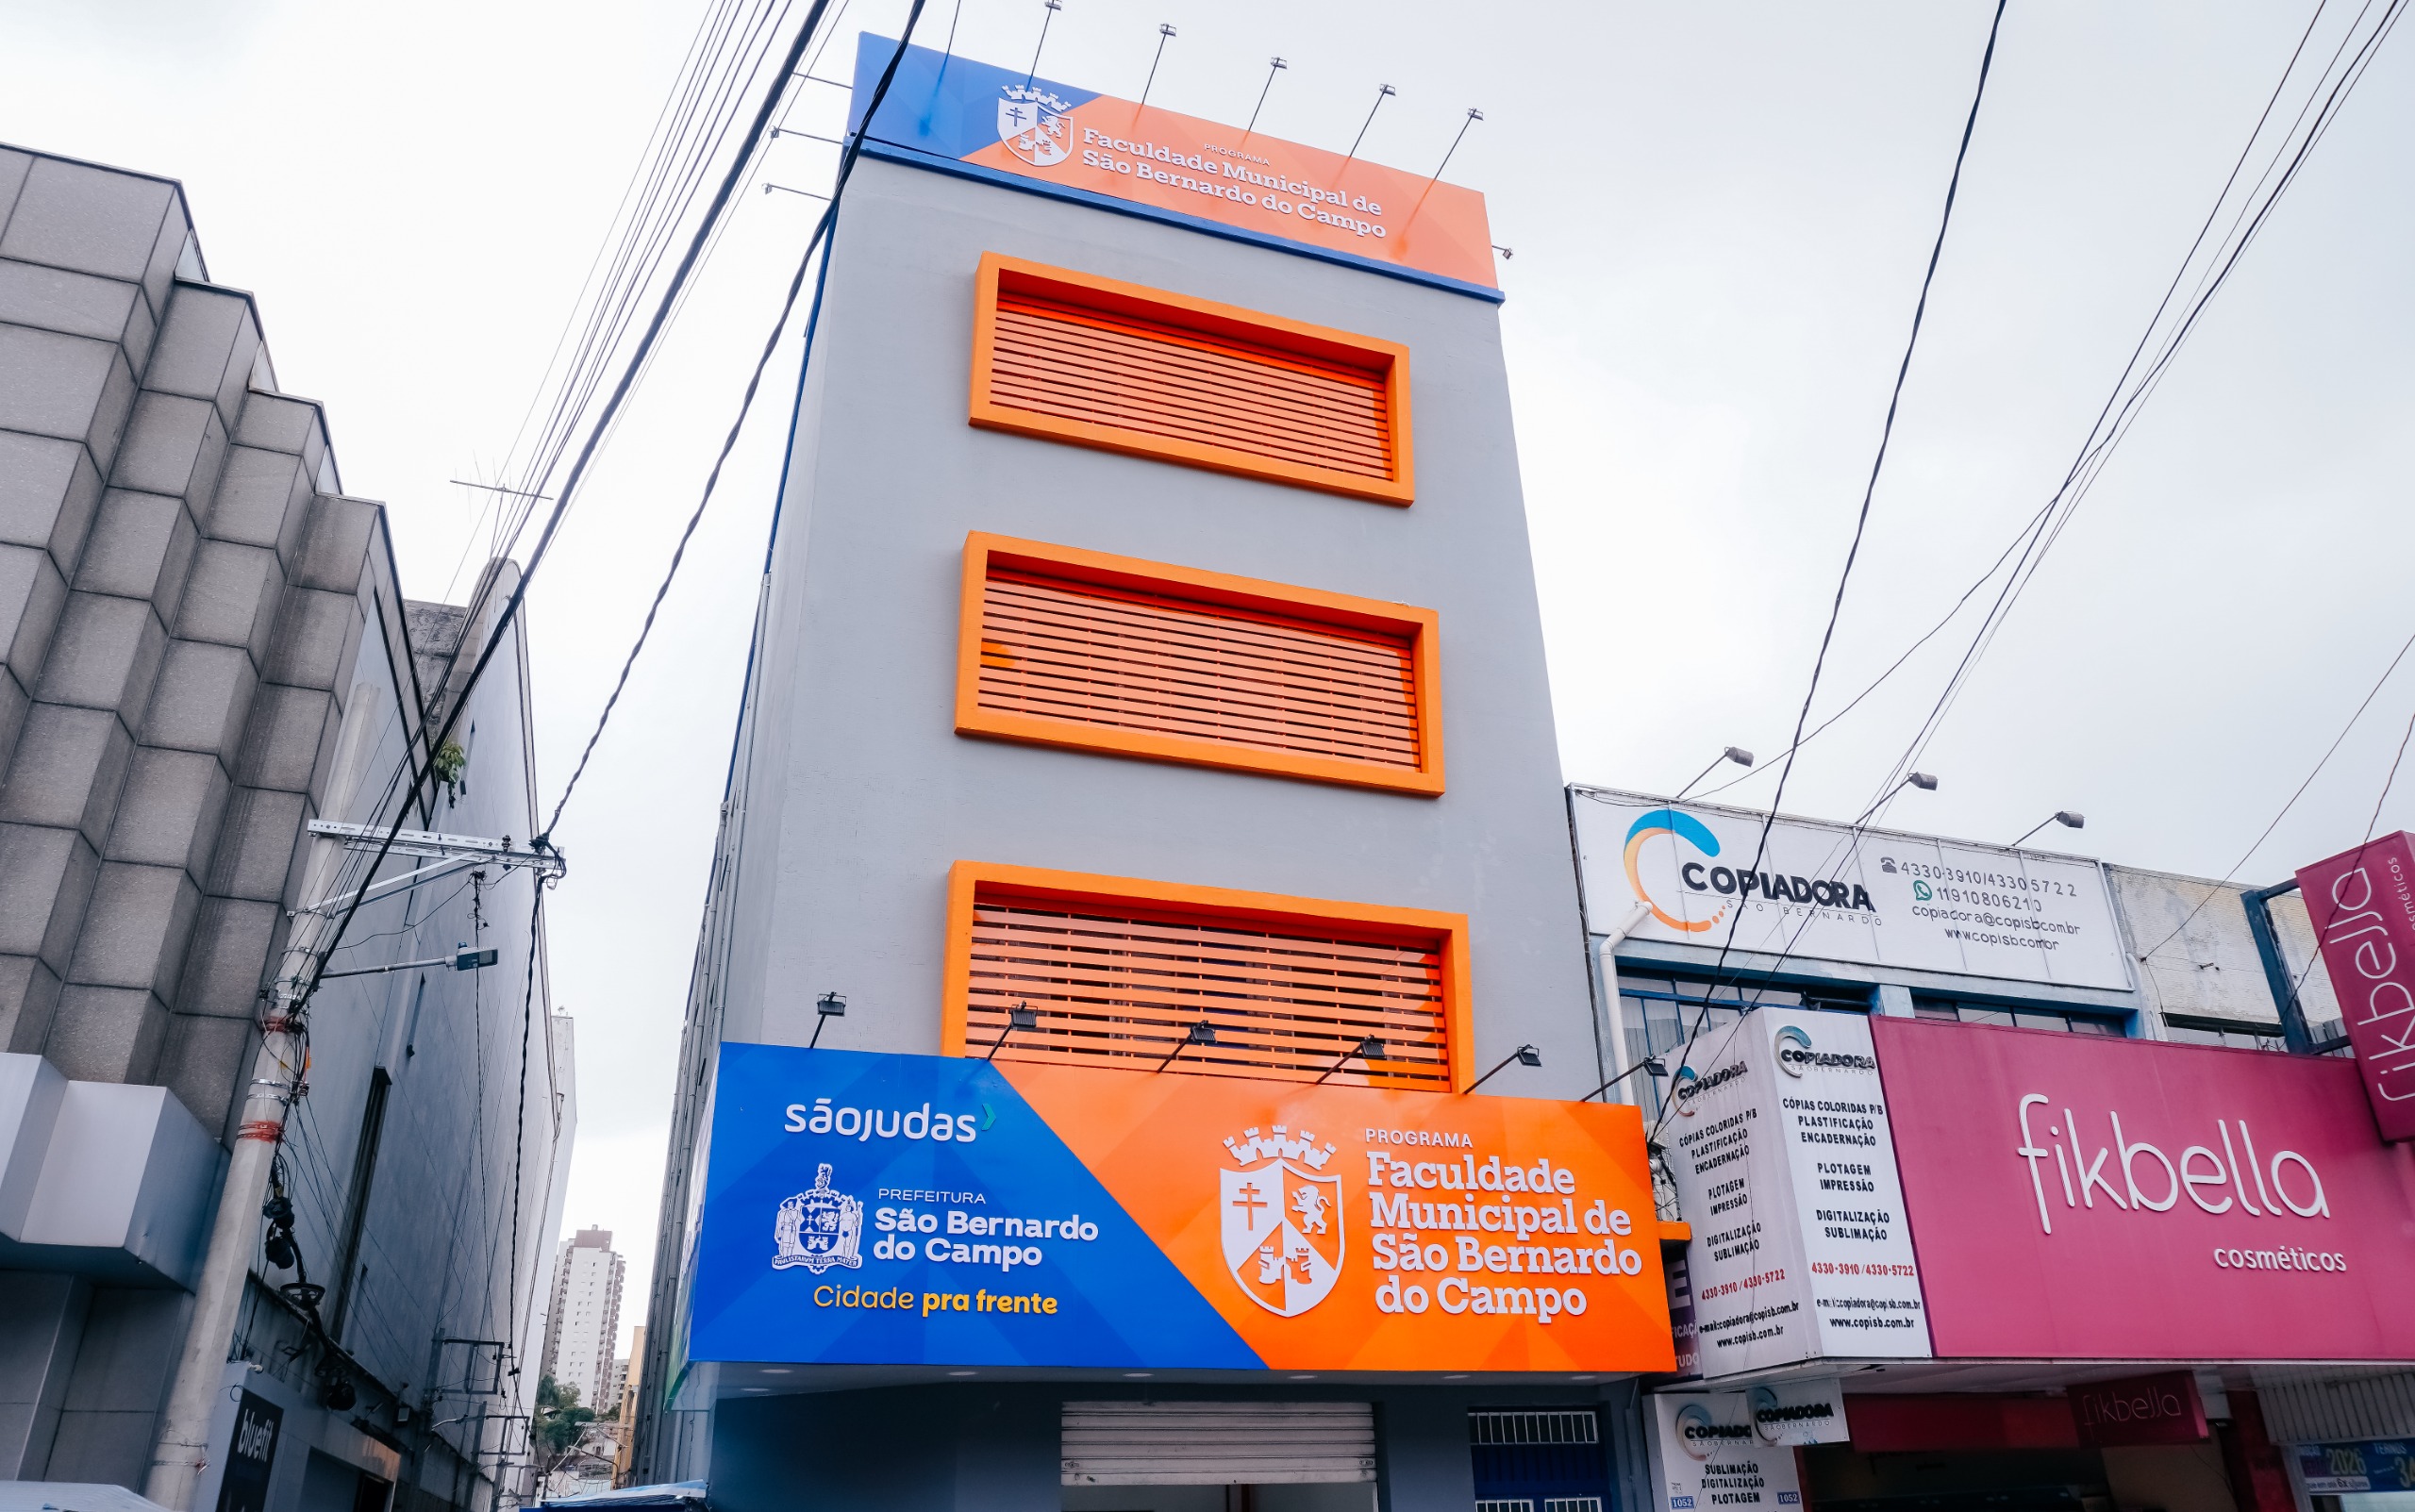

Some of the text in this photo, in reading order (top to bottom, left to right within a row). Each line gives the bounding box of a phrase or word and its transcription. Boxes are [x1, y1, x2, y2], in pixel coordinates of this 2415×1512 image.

[1204, 143, 1271, 166] PROGRAMA
[1083, 127, 1382, 216] Faculdade Municipal de
[1082, 149, 1387, 238] São Bernardo do Campo
[1681, 861, 1877, 913] COPIADORA
[1780, 1048, 1876, 1069] COPIADORA
[1678, 1060, 1749, 1101] COPIADORA
[1782, 1096, 1884, 1115] CÓPIAS COLORIDAS P/B
[784, 1098, 976, 1143] sãojudas
[1679, 1108, 1757, 1148] CÓPIAS COLORIDAS P/B
[1797, 1116, 1874, 1132] PLASTIFICAÇÃO
[1365, 1128, 1474, 1149] PROGRAMA
[1690, 1127, 1748, 1159] PLASTIFICAÇÃO
[1801, 1132, 1876, 1148] ENCADERNAÇÃO
[1694, 1143, 1750, 1174] ENCADERNAÇÃO
[1817, 1162, 1872, 1175] PLOTAGEM
[2017, 1093, 2331, 1235] fikbella
[1366, 1151, 1576, 1195] Faculdade
[1820, 1178, 1874, 1192] IMPRESSÃO
[878, 1188, 987, 1205] PREFEITURA
[1707, 1177, 1745, 1200] PLOTAGEM
[1709, 1192, 1748, 1216] IMPRESSÃO
[874, 1207, 1099, 1241] São Bernardo
[1369, 1192, 1632, 1241] Municipal de
[1816, 1208, 1890, 1226] DIGITALIZAÇÃO
[1707, 1220, 1761, 1247] DIGITALIZAÇÃO
[1824, 1226, 1888, 1242] SUBLIMAÇÃO
[873, 1234, 1042, 1272] do Campo
[1372, 1233, 1643, 1276] São Bernardo
[1713, 1238, 1760, 1262] SUBLIMAÇÃO
[2213, 1245, 2347, 1271] cosméticos
[813, 1284, 1058, 1318] Cidade pra frente
[1375, 1275, 1588, 1324] do Campo
[1829, 1316, 1915, 1330] www.copisb.com.br
[1717, 1324, 1784, 1348] www.copisb.com.br
[1756, 1403, 1835, 1423] COPIADORA
[2082, 1386, 2182, 1442] fikbella
[237, 1408, 275, 1463] bluefit
[1684, 1424, 1753, 1441] COPIADO
[1705, 1460, 1759, 1475] SUBLIMAÇÃO
[1701, 1475, 1765, 1489] DIGITALIZAÇÃO
[1673, 1497, 1693, 1508] 1052
[1711, 1491, 1761, 1505] PLOTAGEM
[1778, 1492, 1799, 1504] 1052
